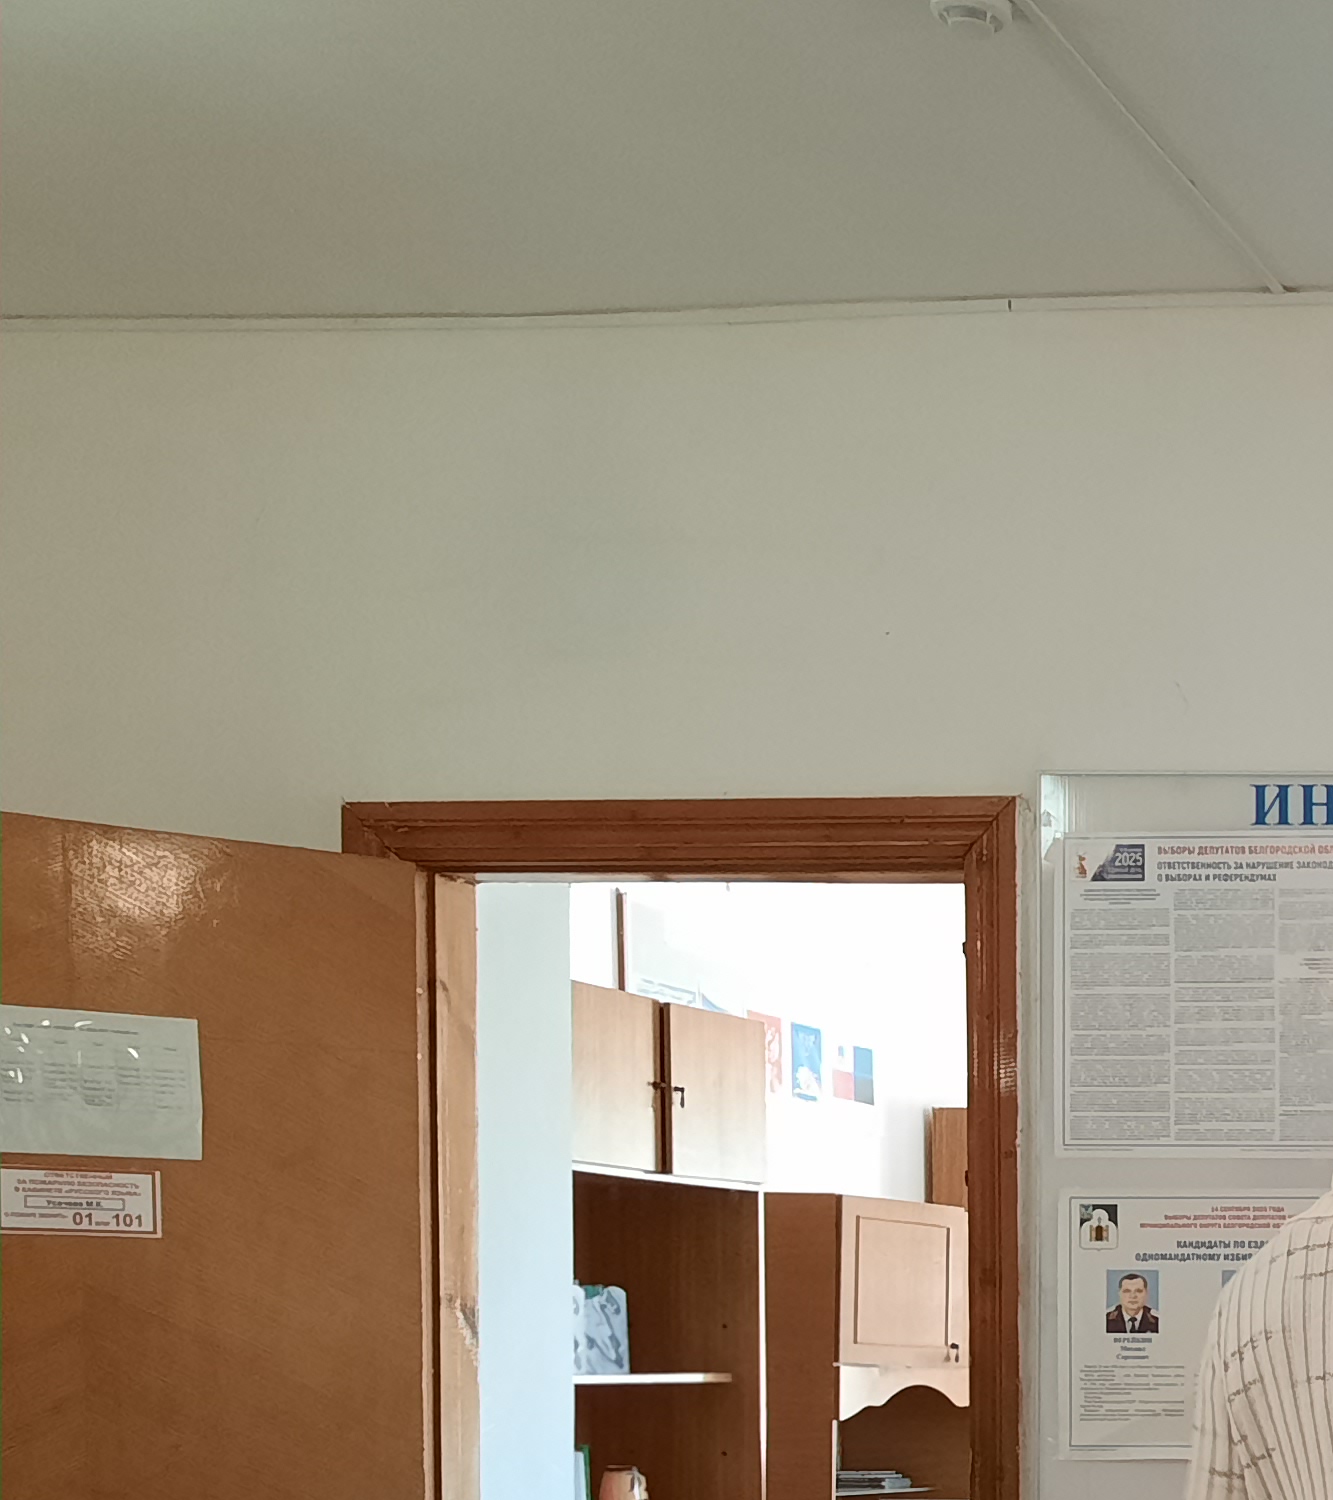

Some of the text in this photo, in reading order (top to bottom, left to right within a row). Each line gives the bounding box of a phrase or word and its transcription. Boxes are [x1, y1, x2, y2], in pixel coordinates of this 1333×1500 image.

[1157, 846, 1195, 855] ВЫБОРЫ
[1197, 846, 1246, 856] ДЕПУТАТОВ
[1115, 852, 1143, 867] 2025
[1157, 861, 1232, 871] ОТВЕТСТВЕННОСТЬ
[1234, 861, 1244, 870] ЗА
[1246, 861, 1294, 870] НАРУШЕНИЕ
[1165, 873, 1202, 882] ВЫБОРАХ
[1212, 873, 1277, 883] РЕФЕРЕНДУМАХ
[72, 1211, 93, 1226] 01
[112, 1213, 143, 1227] 101
[1176, 1240, 1231, 1249] КАНДИДАТЫ
[1233, 1240, 1245, 1249] ПО
[1135, 1253, 1221, 1262] ОДНОМАНДАТНОМУ
